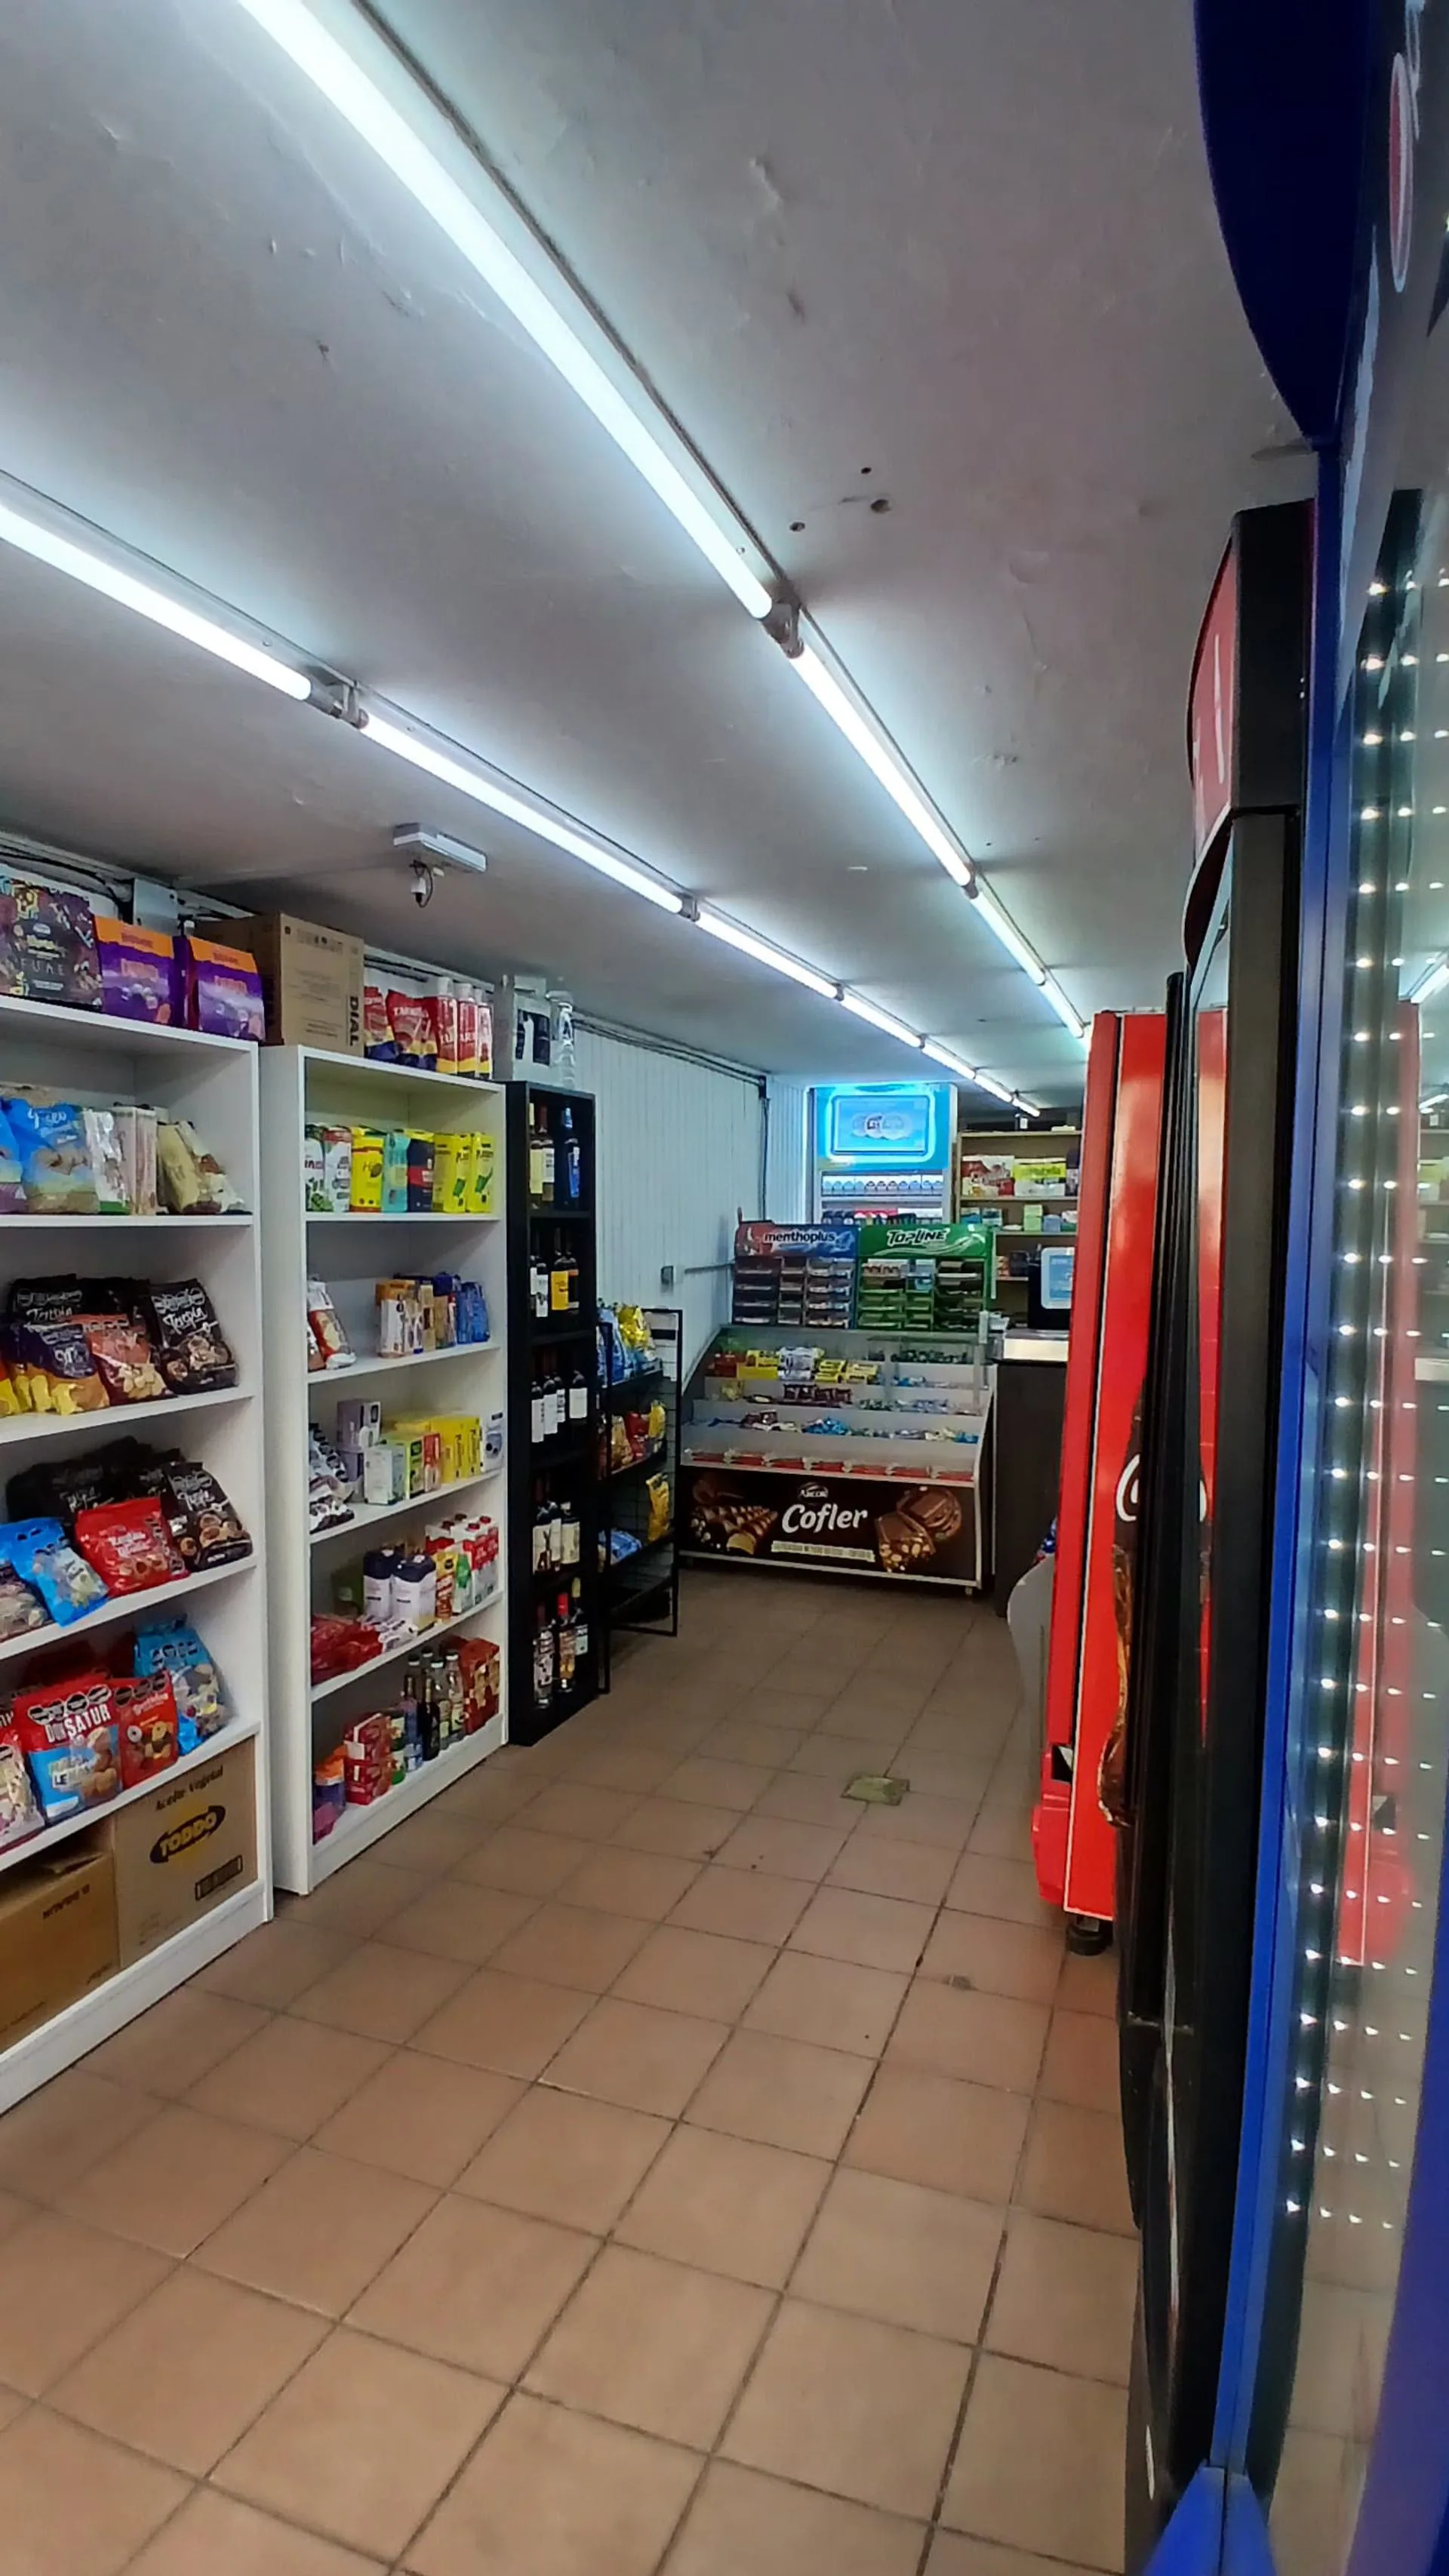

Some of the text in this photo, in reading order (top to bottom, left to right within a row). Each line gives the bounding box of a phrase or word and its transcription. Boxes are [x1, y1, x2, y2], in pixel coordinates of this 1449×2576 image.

[764, 1230, 835, 1244] menthoplus
[782, 1503, 868, 1534] Cofler
[63, 1703, 112, 1737] SATUR
